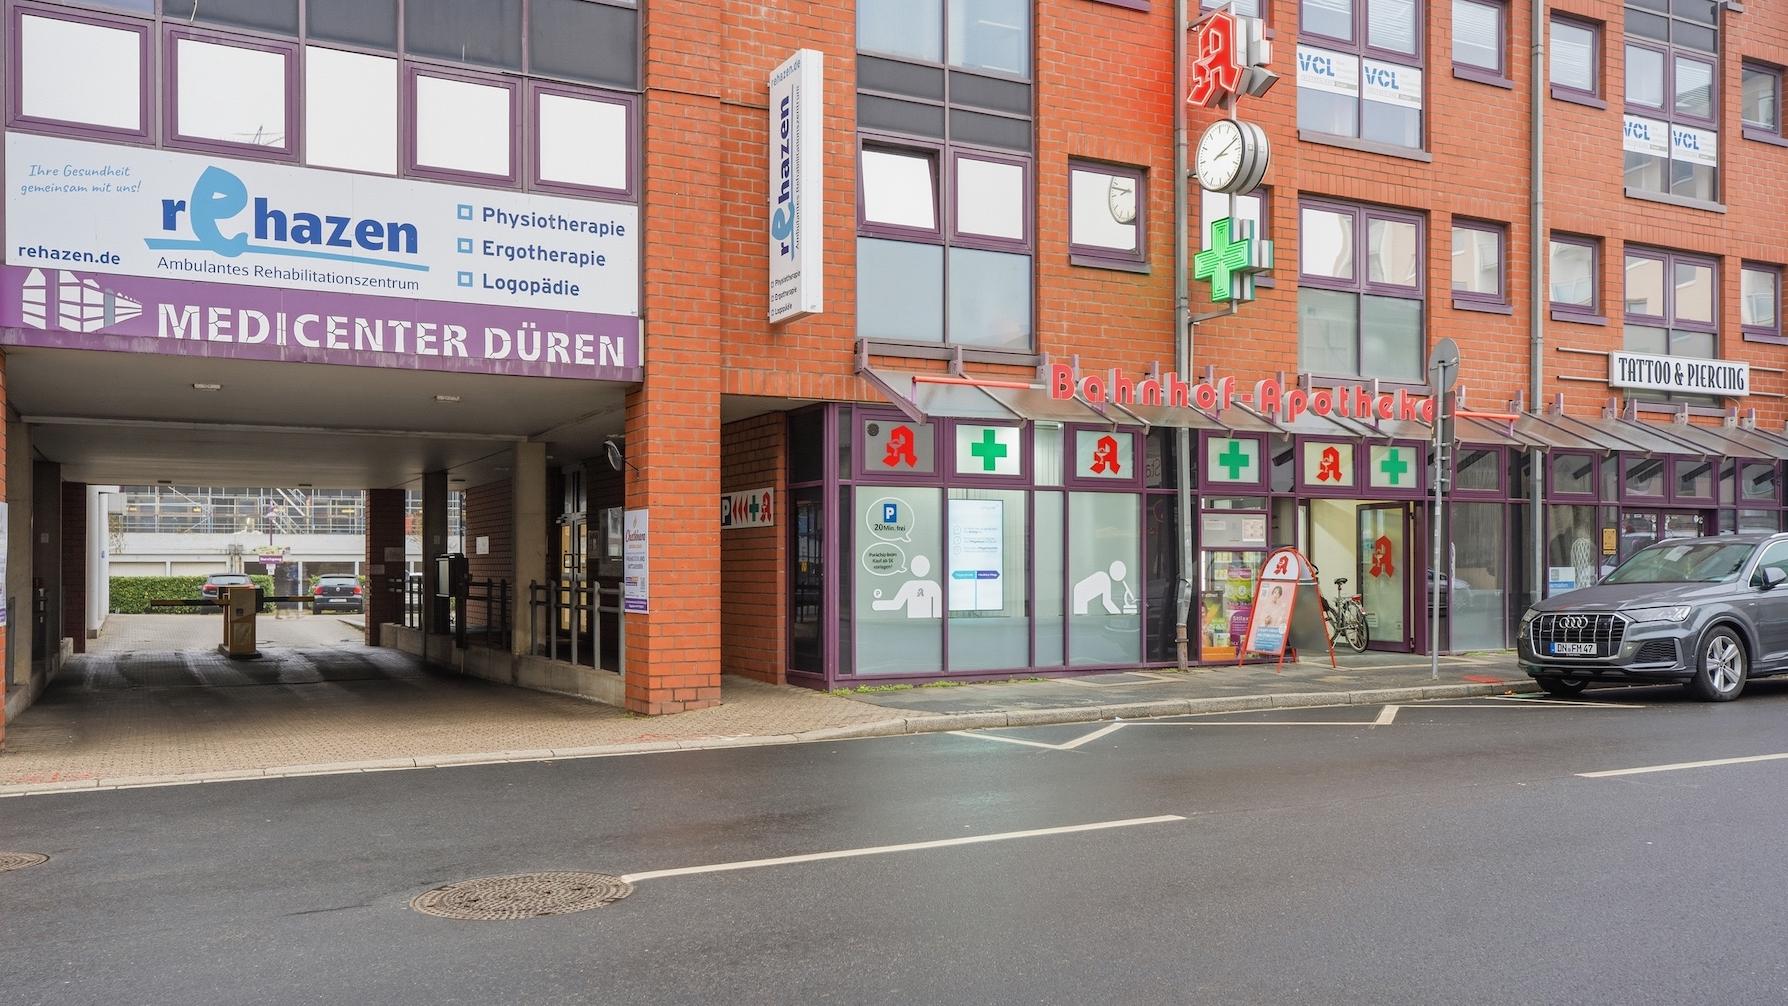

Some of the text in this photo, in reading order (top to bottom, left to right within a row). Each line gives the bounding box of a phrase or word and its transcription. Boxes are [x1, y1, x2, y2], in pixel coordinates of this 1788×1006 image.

[1299, 52, 1335, 77] VCL
[1364, 66, 1399, 90] VCL
[1624, 121, 1650, 141] VCL
[1672, 130, 1700, 151] VCL
[28, 164, 131, 178] Ihre Gesundheit
[772, 96, 795, 256] rehazen
[20, 180, 142, 195] gemeinsam mit uns!
[161, 166, 418, 257] rehazen
[482, 206, 626, 238] Physiotherapie
[18, 244, 121, 266] rehazen.de
[483, 240, 606, 268] Ergotherapie
[157, 256, 419, 291] Ambulantes Rehabilitationszentrum
[483, 273, 580, 296] Logopädie
[158, 303, 625, 367] MEDICENTER DÜREN
[1619, 357, 1745, 391] TATTOO & PIERCING
[885, 506, 895, 520] P
[1557, 643, 1593, 653] DN FM 47
